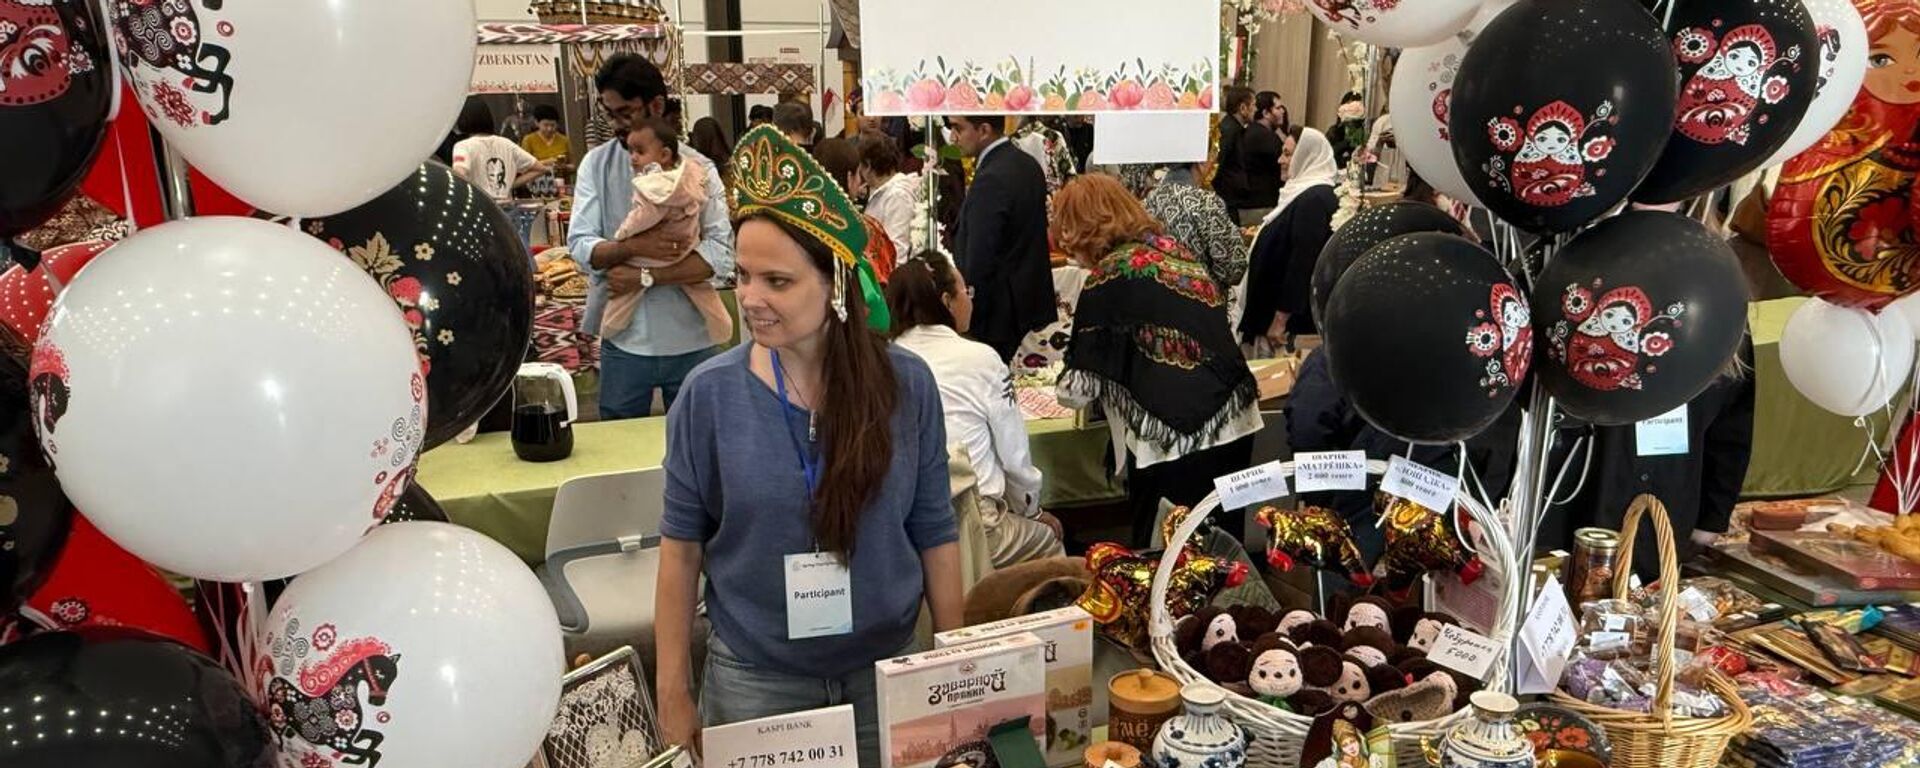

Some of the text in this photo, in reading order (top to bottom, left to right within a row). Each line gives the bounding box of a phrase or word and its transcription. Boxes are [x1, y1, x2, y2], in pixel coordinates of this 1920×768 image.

[478, 54, 550, 65] ZBEKISTAN
[794, 587, 846, 600] Participant
[757, 721, 813, 735] KASPI BANK
[750, 754, 776, 768] 778
[779, 749, 805, 765] 742
[808, 747, 825, 760] 00
[829, 744, 844, 758] 31
